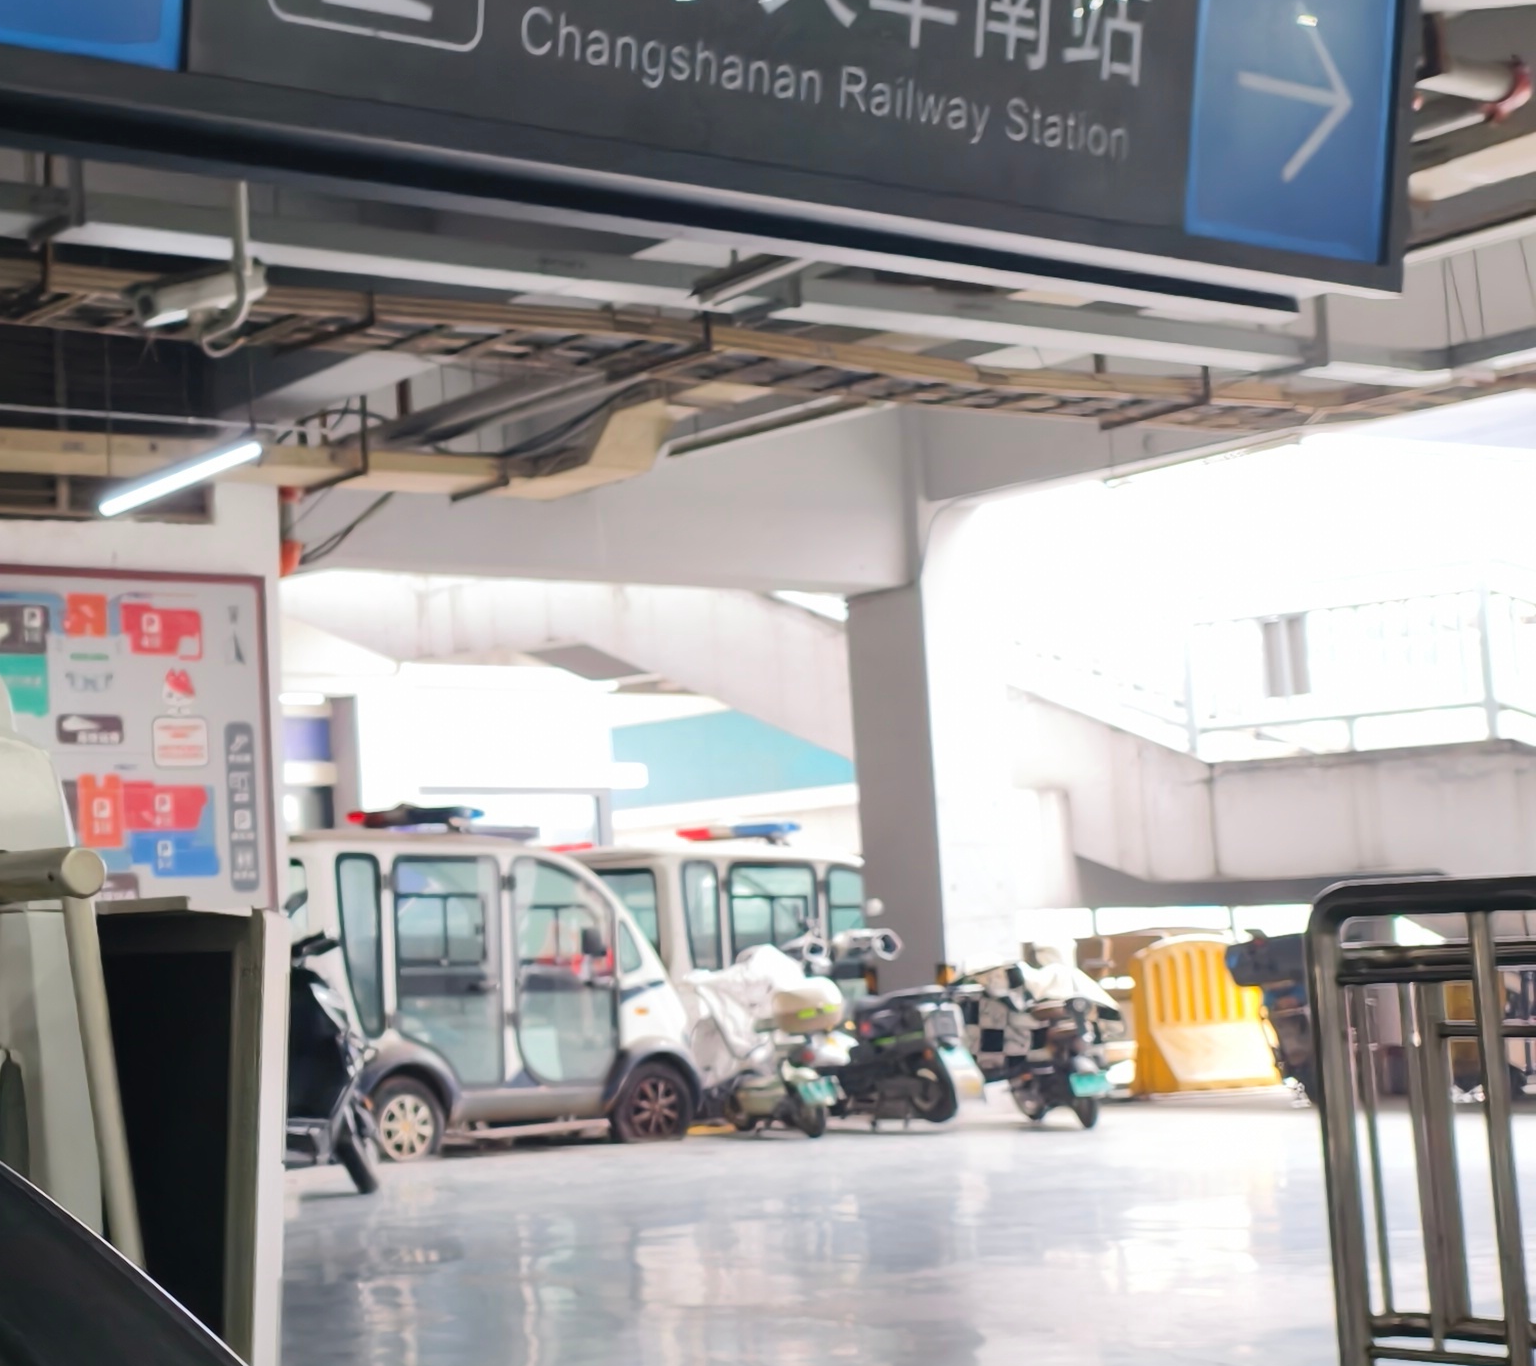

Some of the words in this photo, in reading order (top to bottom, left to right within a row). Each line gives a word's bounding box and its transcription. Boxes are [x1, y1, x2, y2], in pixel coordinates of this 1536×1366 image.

[520, 4, 823, 106] Changshanan
[838, 64, 992, 145] Railway
[1003, 96, 1131, 163] Station
